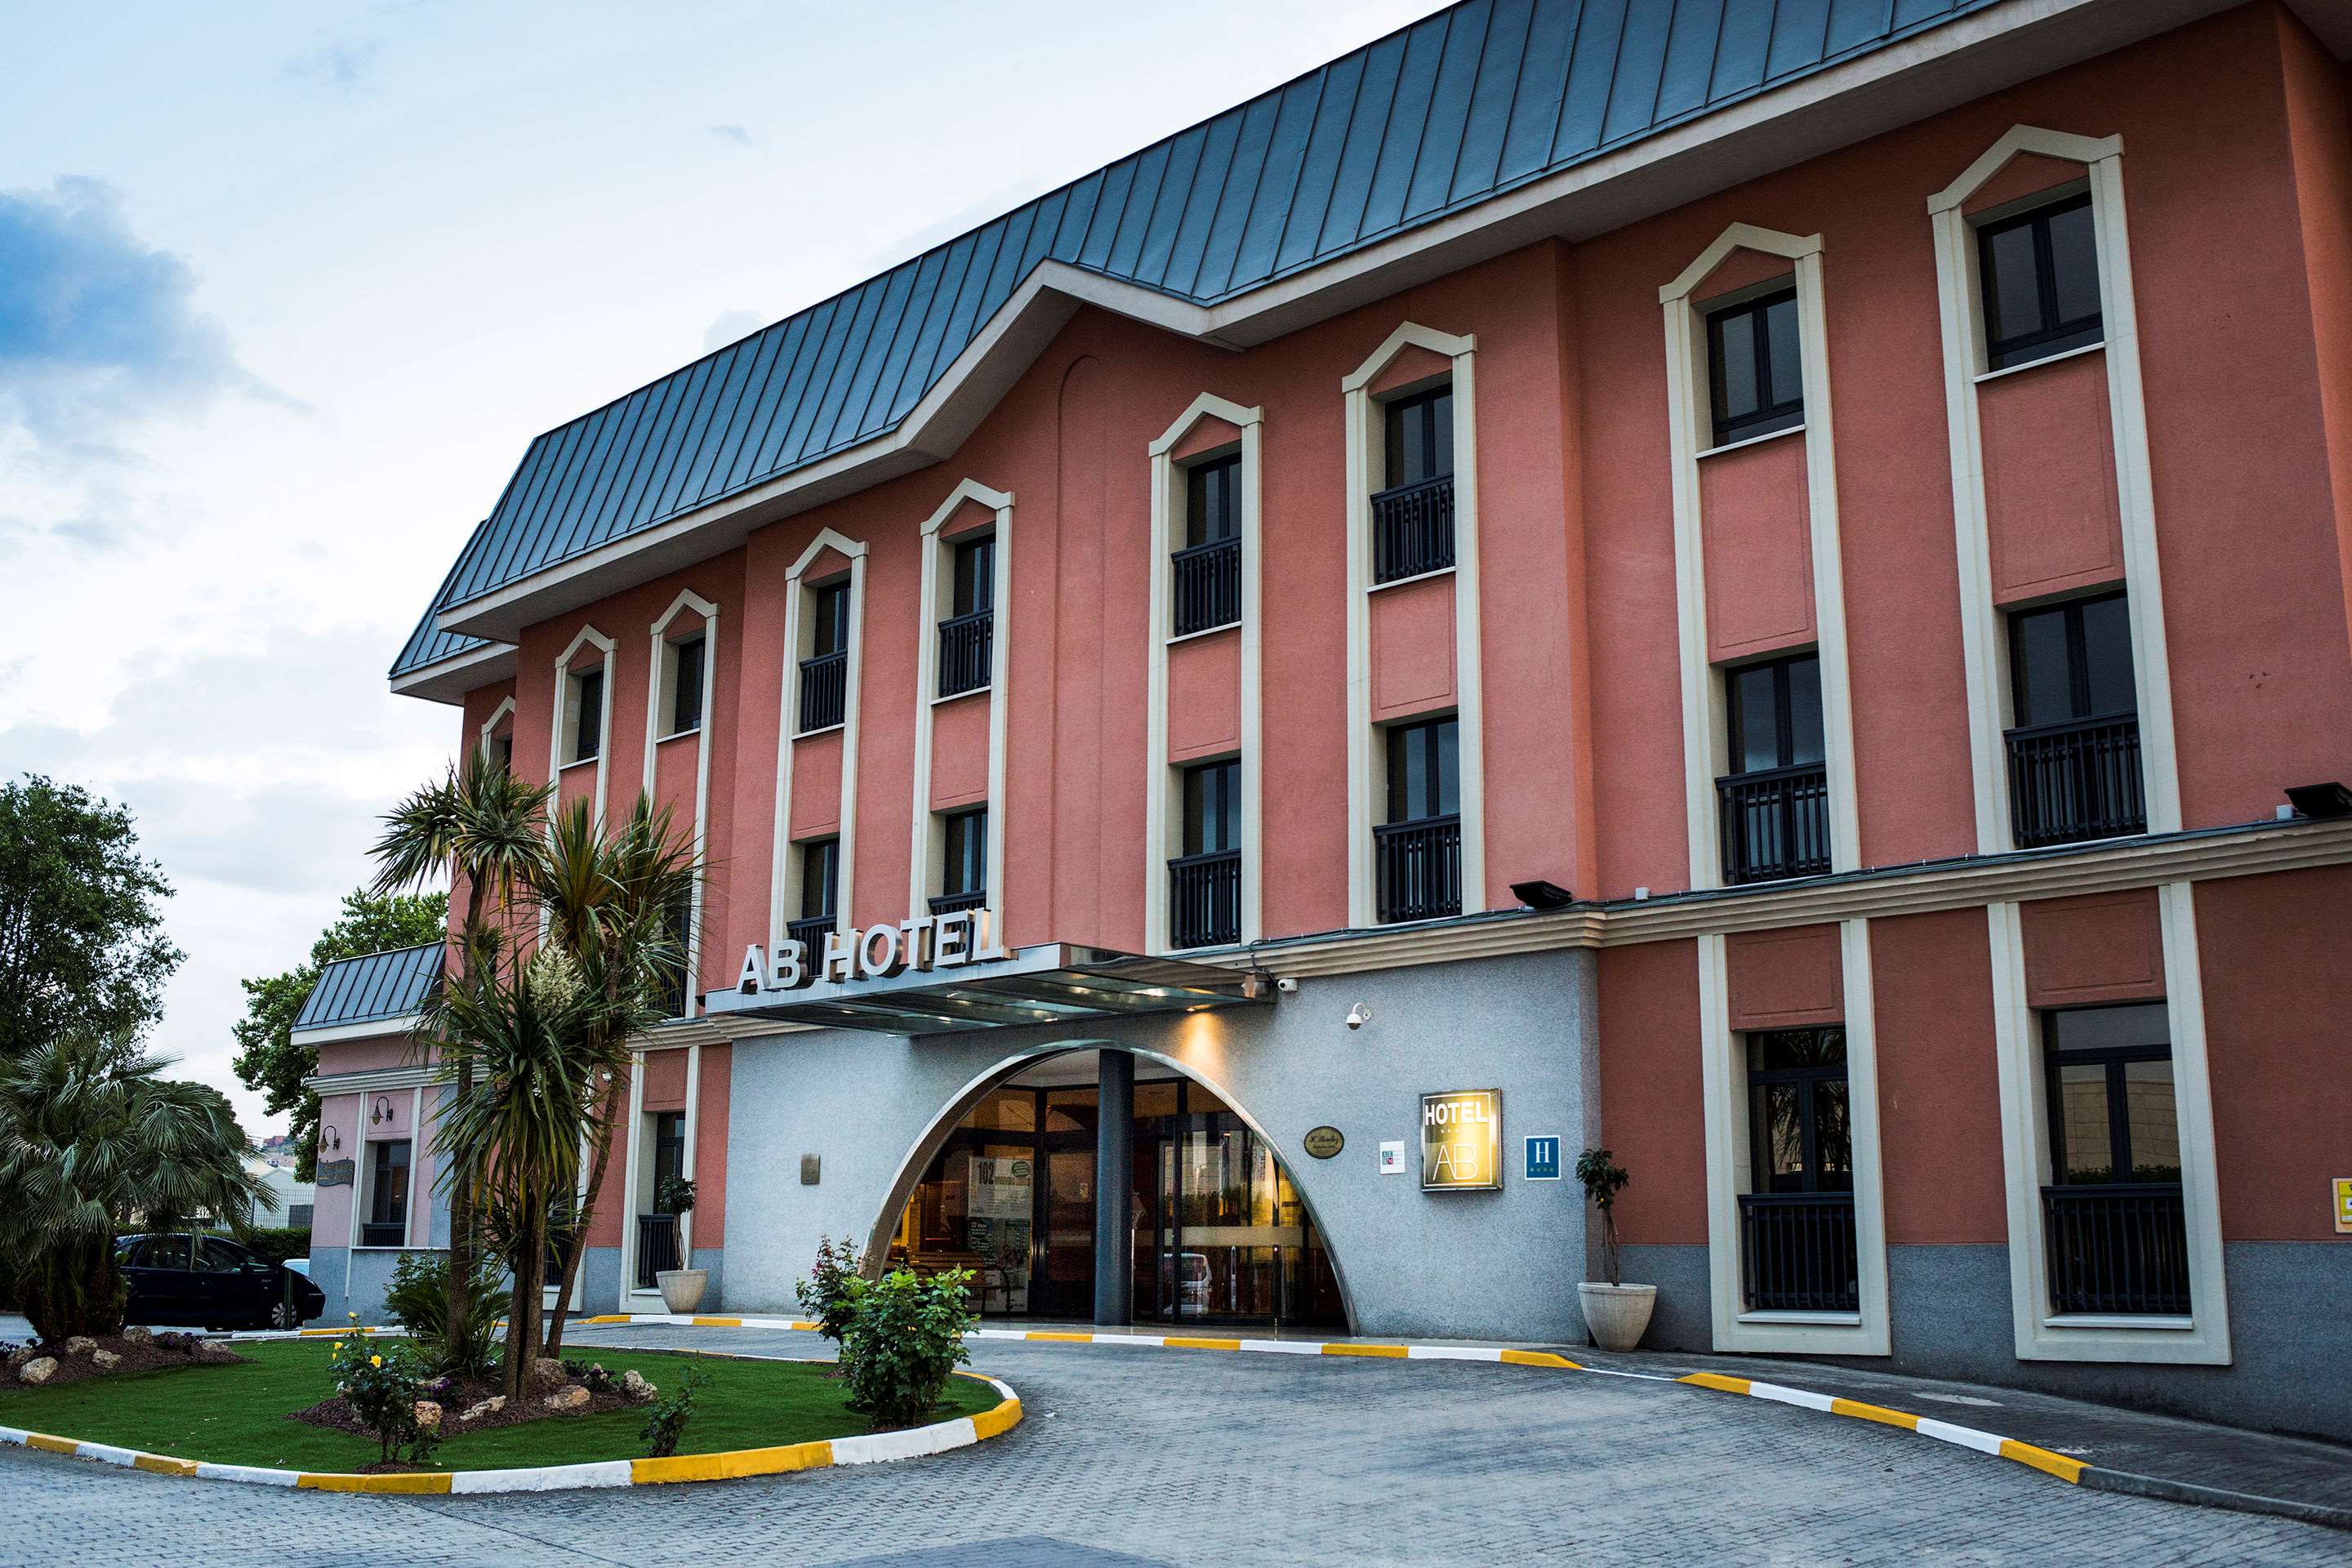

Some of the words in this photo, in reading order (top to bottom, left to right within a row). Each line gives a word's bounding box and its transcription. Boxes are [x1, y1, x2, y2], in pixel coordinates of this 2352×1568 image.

[736, 938, 801, 994] AB
[822, 907, 1004, 982] HOTEL
[1424, 1102, 1490, 1125] HOTEL
[1432, 1144, 1477, 1181] AB
[1535, 1142, 1550, 1163] H
